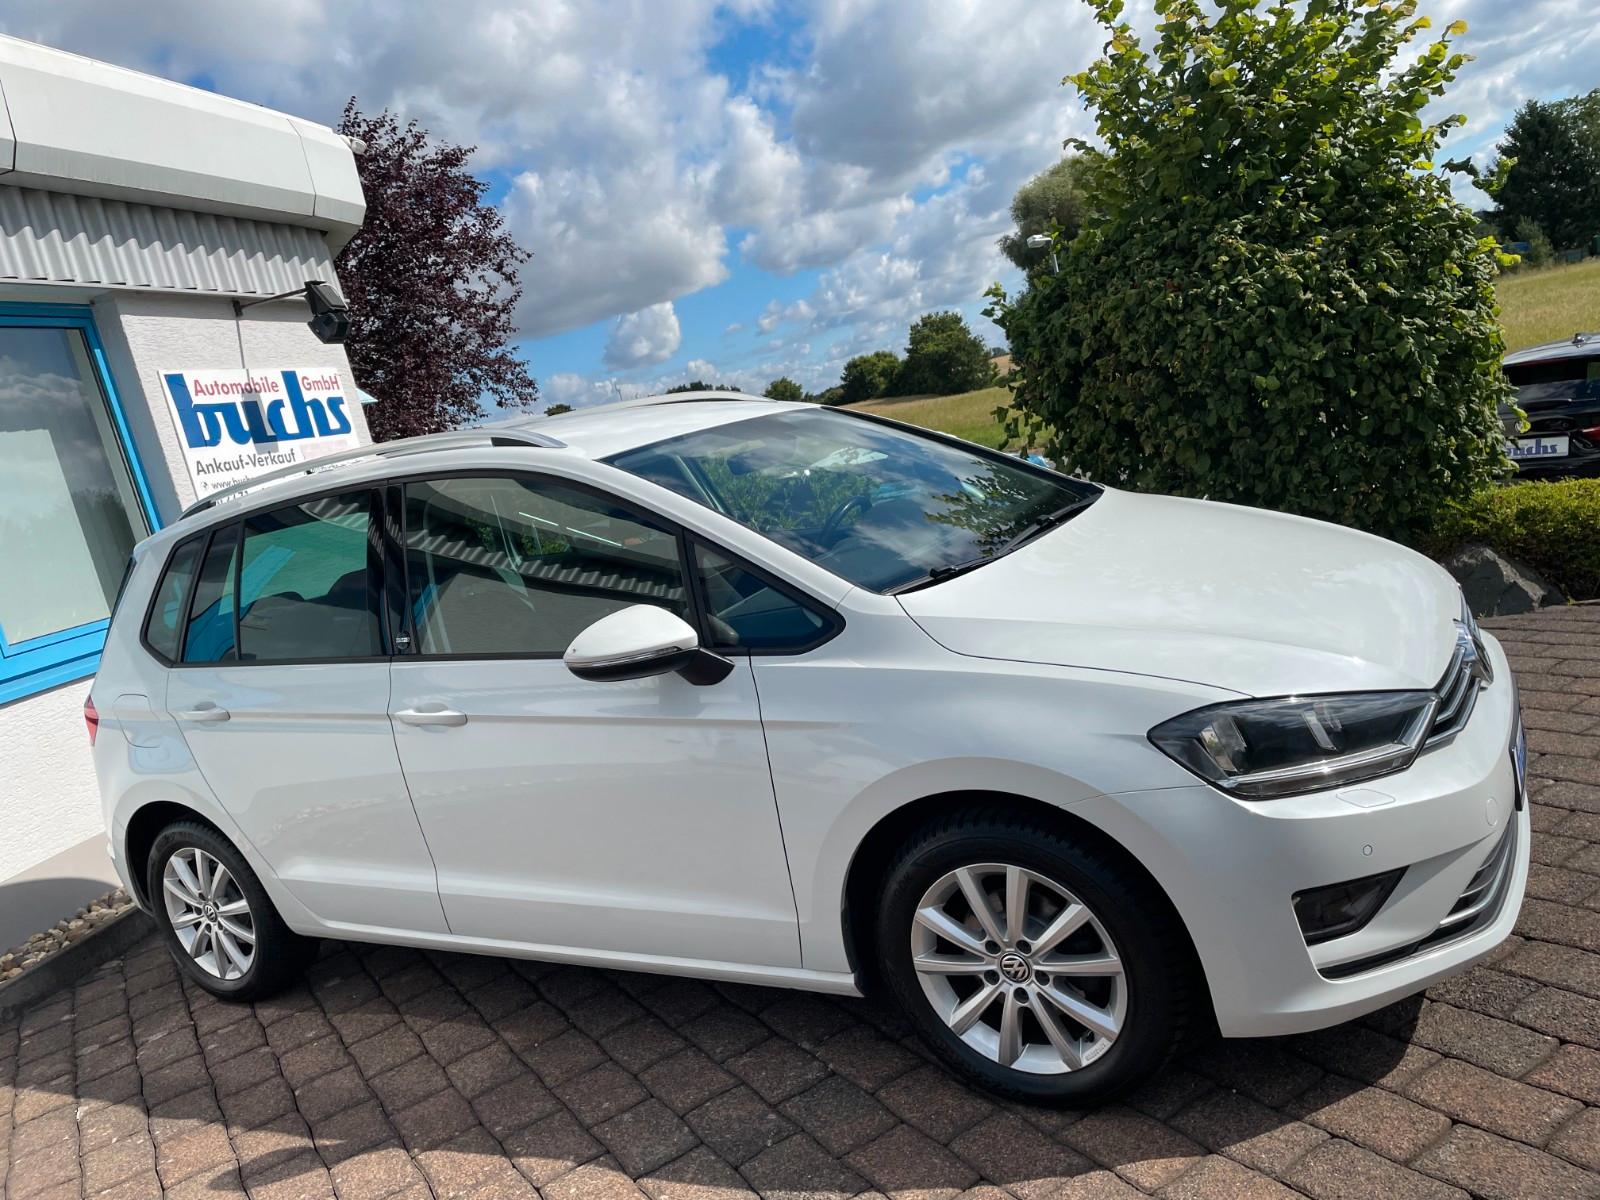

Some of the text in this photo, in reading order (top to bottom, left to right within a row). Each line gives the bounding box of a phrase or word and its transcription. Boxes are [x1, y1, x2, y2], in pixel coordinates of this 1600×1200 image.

[194, 374, 340, 397] Automobile GmbH
[164, 370, 352, 449] buchs
[196, 447, 296, 476] Ankauf-Verkauf
